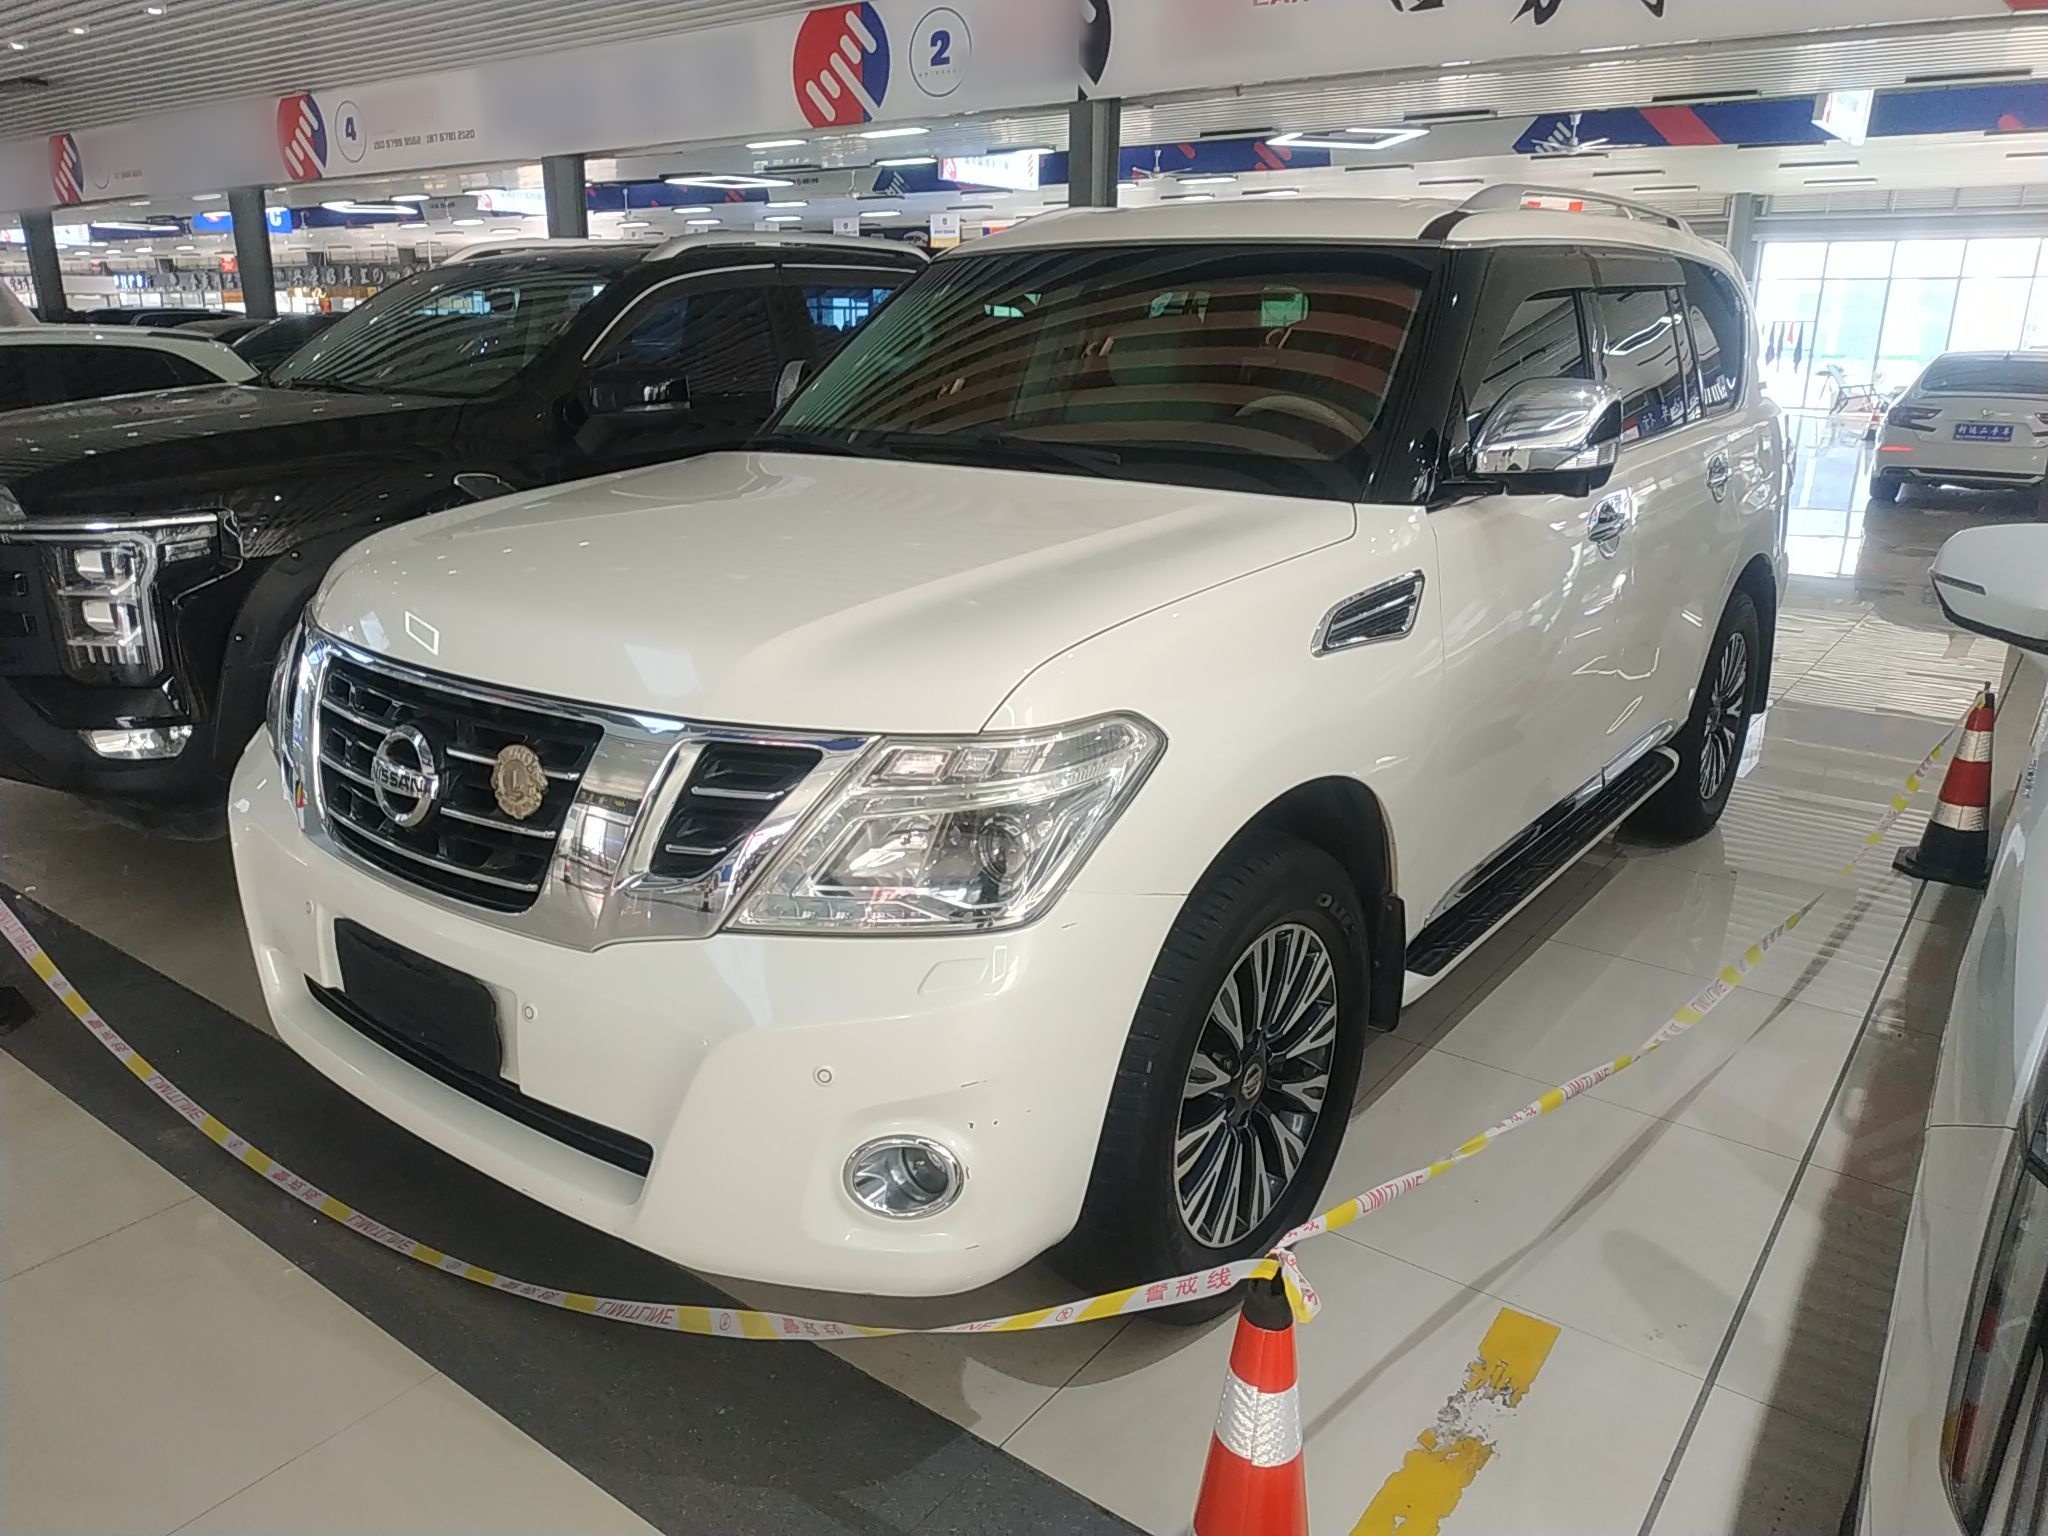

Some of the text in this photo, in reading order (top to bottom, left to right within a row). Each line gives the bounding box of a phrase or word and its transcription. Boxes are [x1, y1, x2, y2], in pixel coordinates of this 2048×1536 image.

[930, 29, 951, 67] 2
[345, 116, 357, 141] 4
[372, 758, 426, 795] NISSAN
[1144, 1267, 1233, 1303] 警戒线
